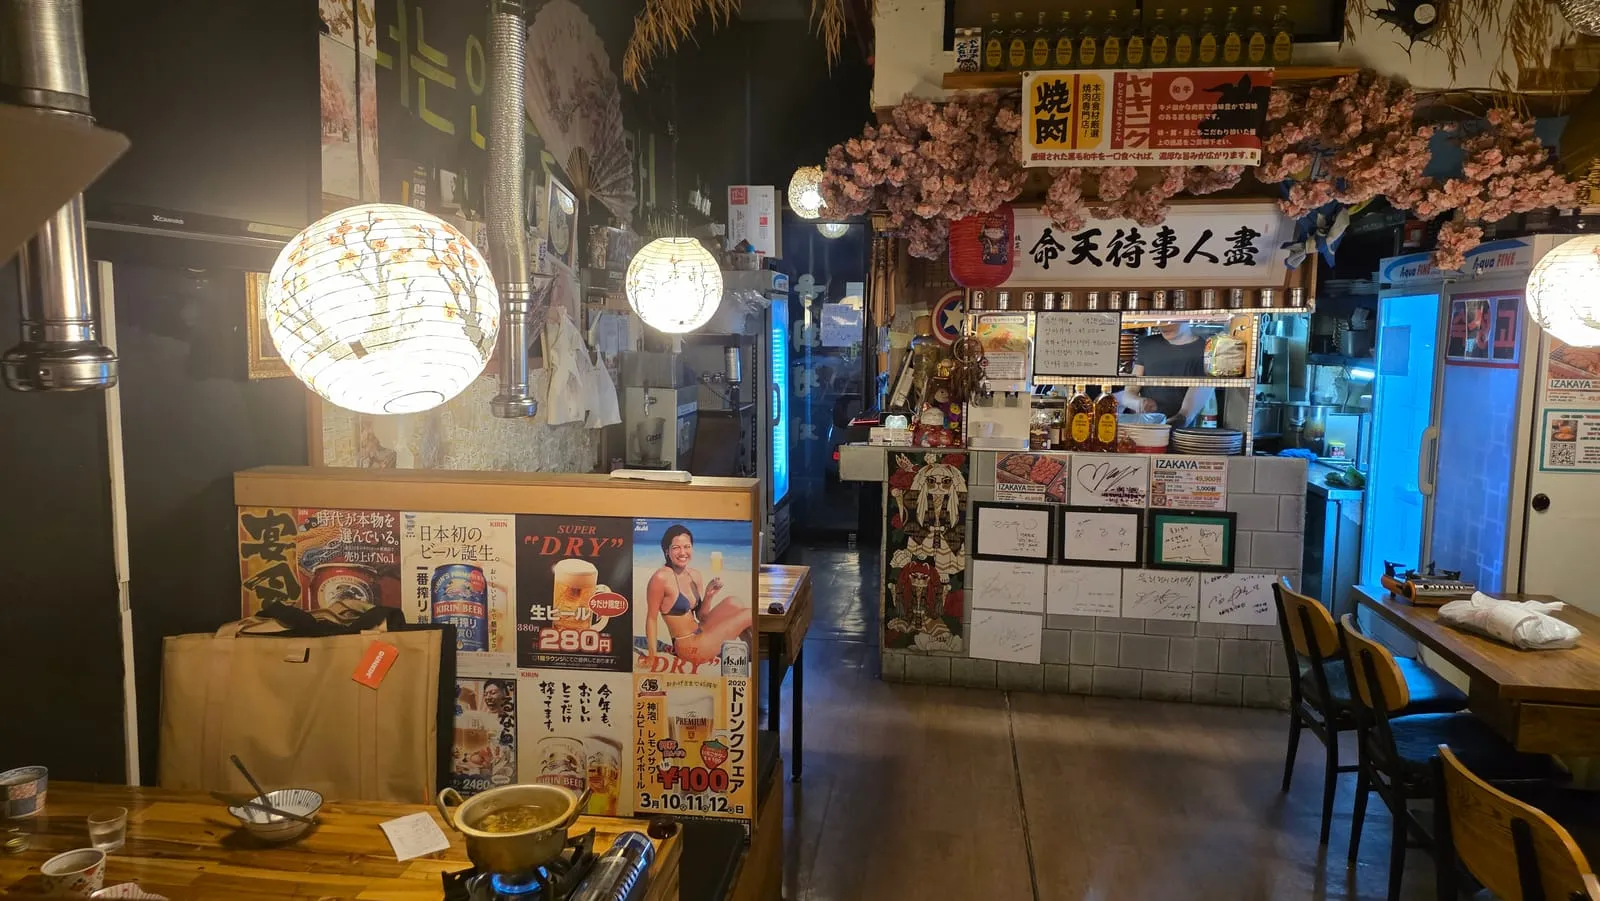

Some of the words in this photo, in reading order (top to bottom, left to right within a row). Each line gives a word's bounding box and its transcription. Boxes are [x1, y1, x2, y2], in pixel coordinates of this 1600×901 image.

[1034, 79, 1071, 144] 焼肉
[1124, 75, 1152, 148] ヤキニク
[1472, 257, 1495, 271] Aqua
[1496, 252, 1516, 268] FINE
[1399, 266, 1416, 278] Aqua
[1416, 264, 1432, 276] FINE
[1550, 379, 1591, 389] IZAKAYA
[1155, 459, 1198, 470] IZAKAYA
[998, 483, 1028, 492] IZAKAYA
[317, 509, 396, 529] 時代が本物を
[340, 528, 399, 545] 選んでいる。
[420, 525, 482, 543] 日本初の
[557, 525, 597, 535] SUPER
[421, 544, 501, 562] ビール誕生。
[435, 603, 461, 616] KIRIN
[462, 604, 483, 616] BEER
[530, 604, 591, 621] 生ビール
[517, 623, 540, 633] 380円
[540, 629, 612, 651] 280円
[723, 655, 747, 666] Asahi
[728, 679, 747, 687] 2020
[561, 682, 573, 723] とこだけ
[578, 682, 593, 723] おいしい
[597, 684, 613, 728] 今年も、
[675, 716, 707, 727] PREMIUM
[636, 702, 646, 790] ジムビームハイボール
[729, 687, 745, 794] ドリンクフェア
[462, 778, 490, 790] 2480
[563, 776, 585, 788] BEER
[657, 766, 729, 793] ¥100
